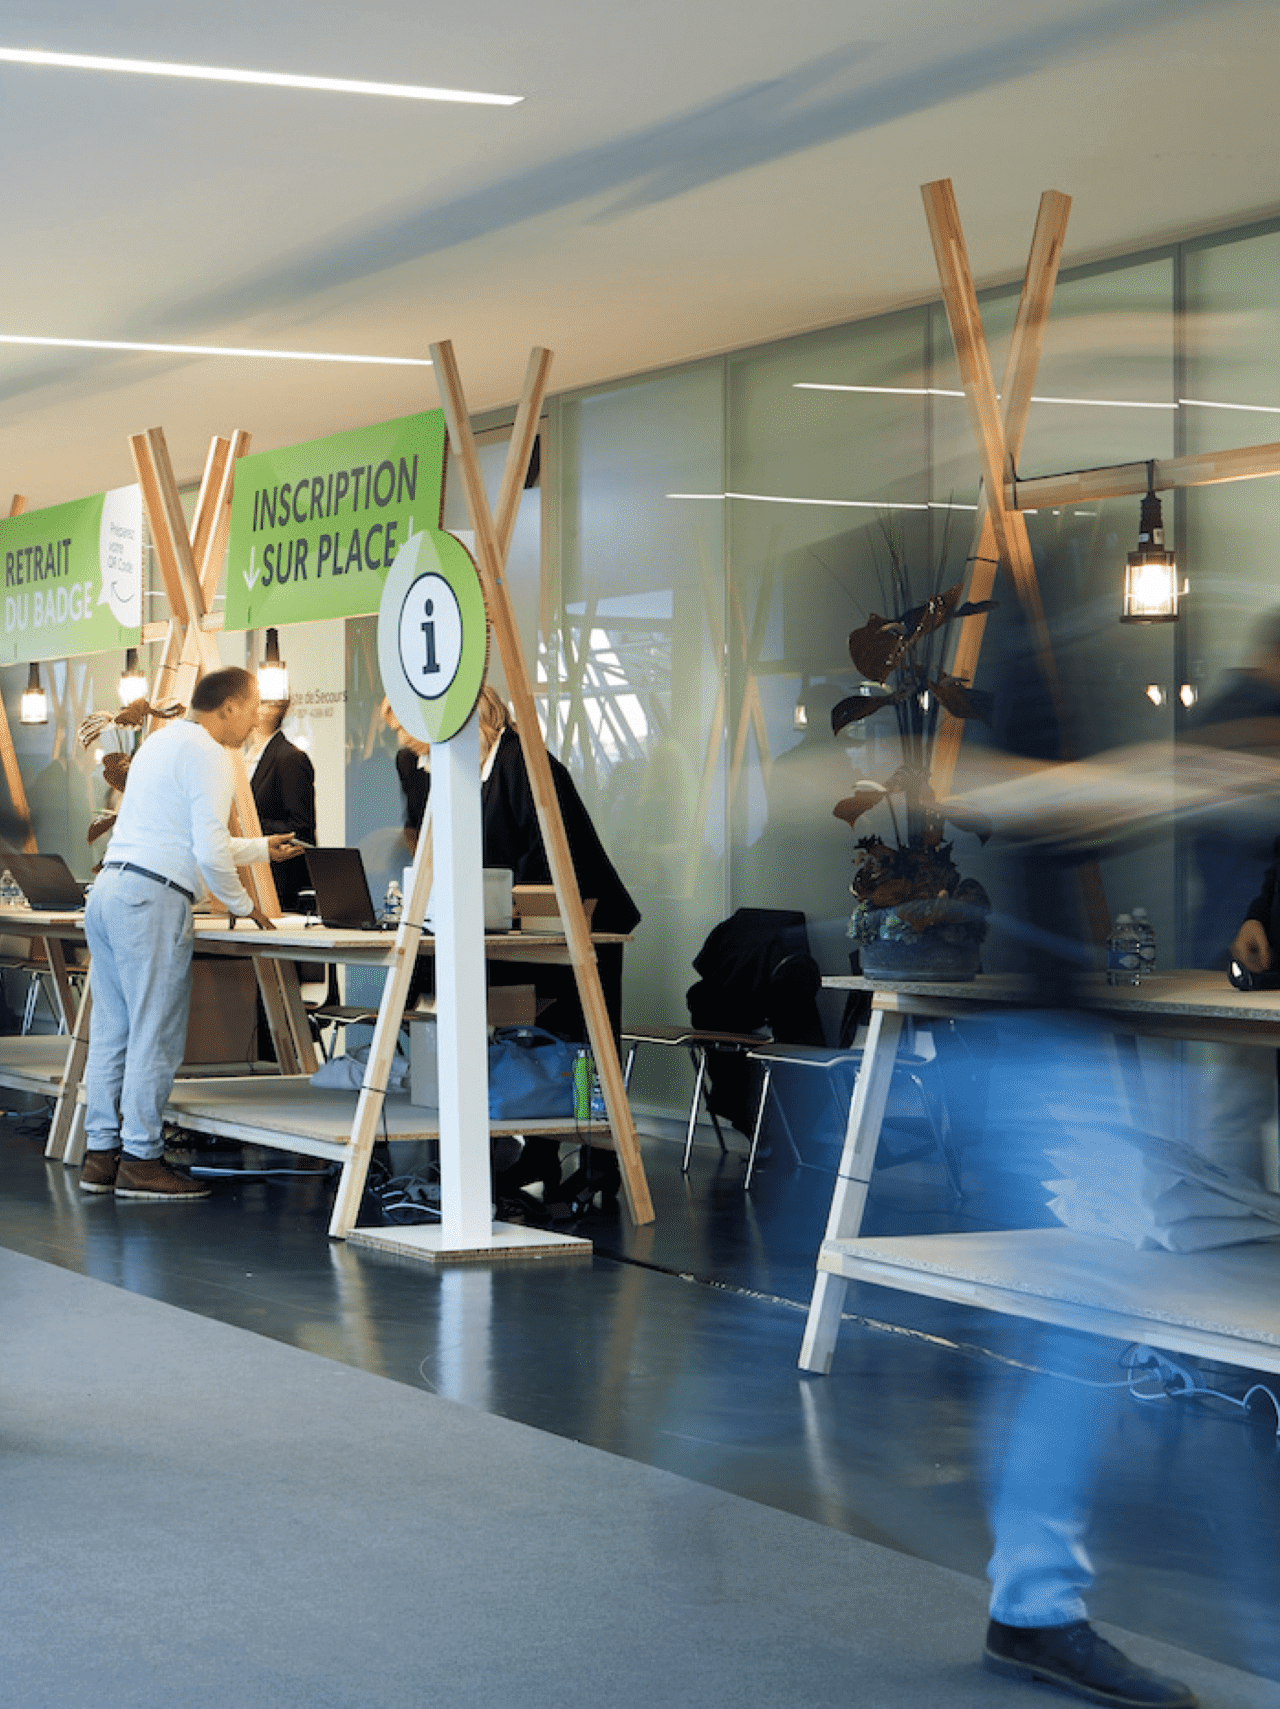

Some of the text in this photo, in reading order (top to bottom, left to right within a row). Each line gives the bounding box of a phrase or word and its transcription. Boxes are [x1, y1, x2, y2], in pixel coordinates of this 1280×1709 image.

[253, 454, 418, 532] INSCRIPTION
[6, 538, 72, 587] RETRAIT
[261, 521, 398, 587] SUR PLACE
[5, 581, 93, 632] DU BADGE
